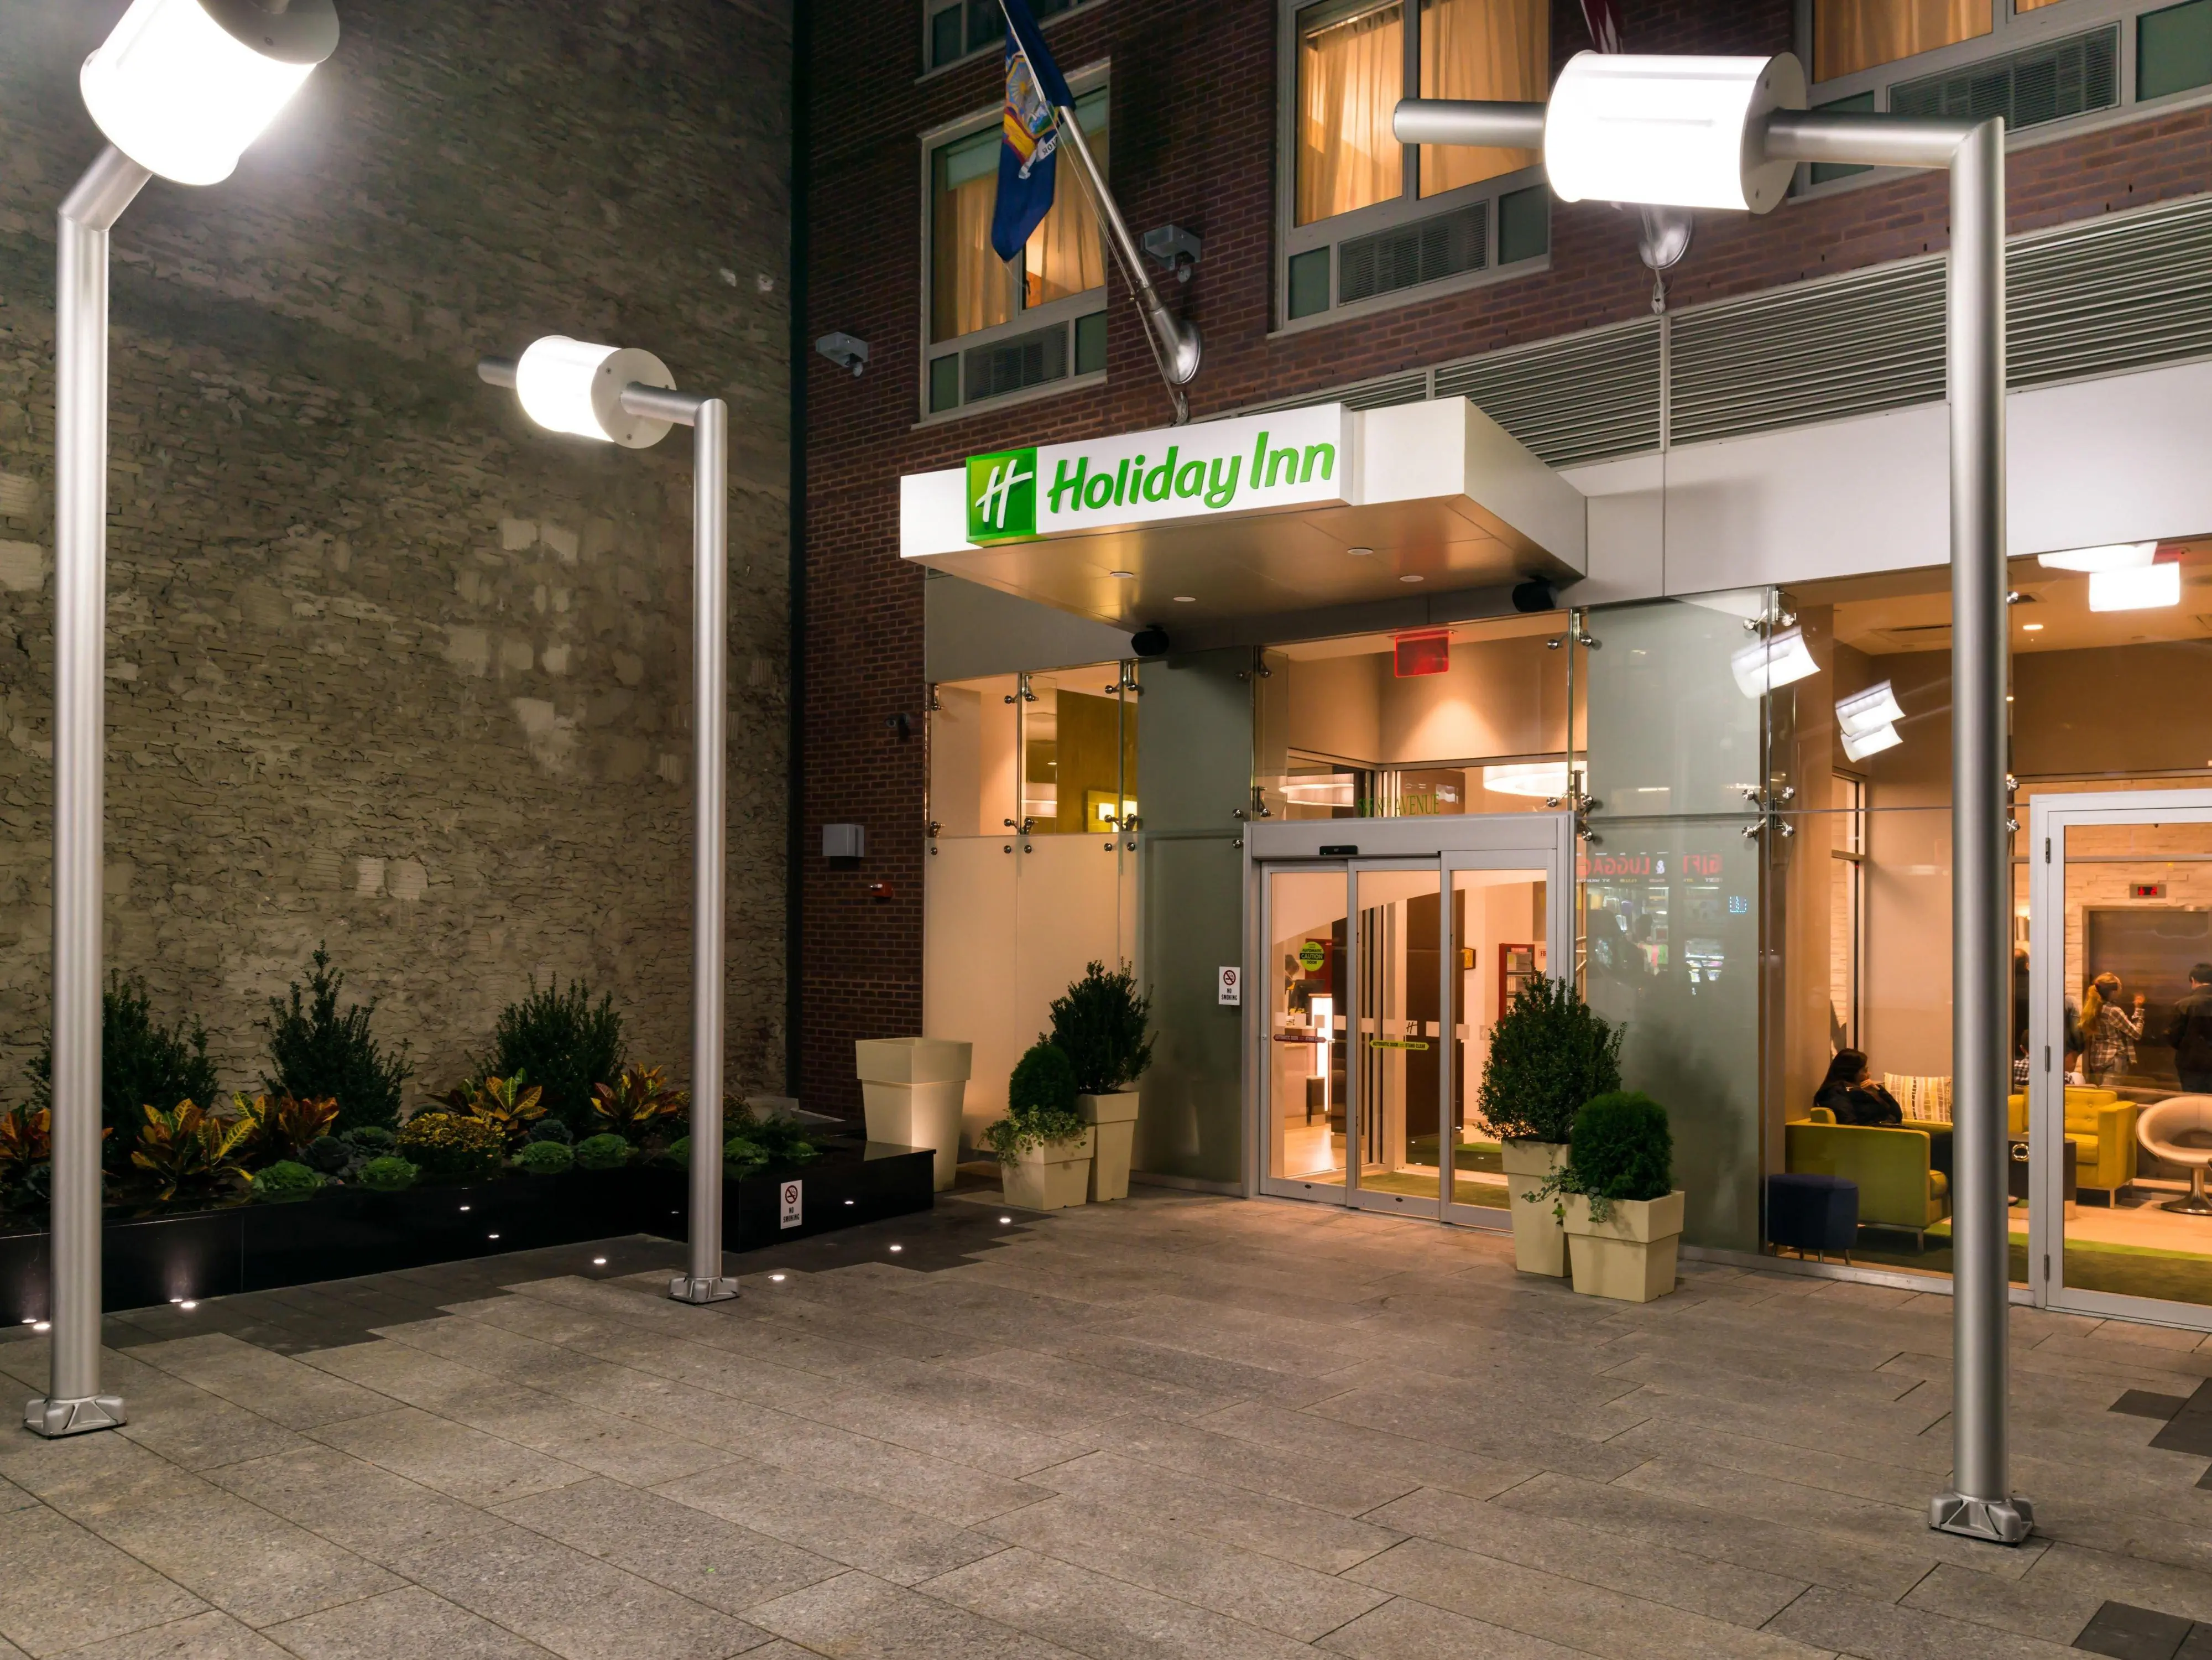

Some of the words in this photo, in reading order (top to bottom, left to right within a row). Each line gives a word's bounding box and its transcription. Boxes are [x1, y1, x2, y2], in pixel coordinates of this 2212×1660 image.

[1046, 445, 1242, 513] Holiday
[1250, 431, 1335, 490] Inn
[1395, 794, 1440, 817] AVENUE
[783, 1214, 800, 1223] SMOKING
